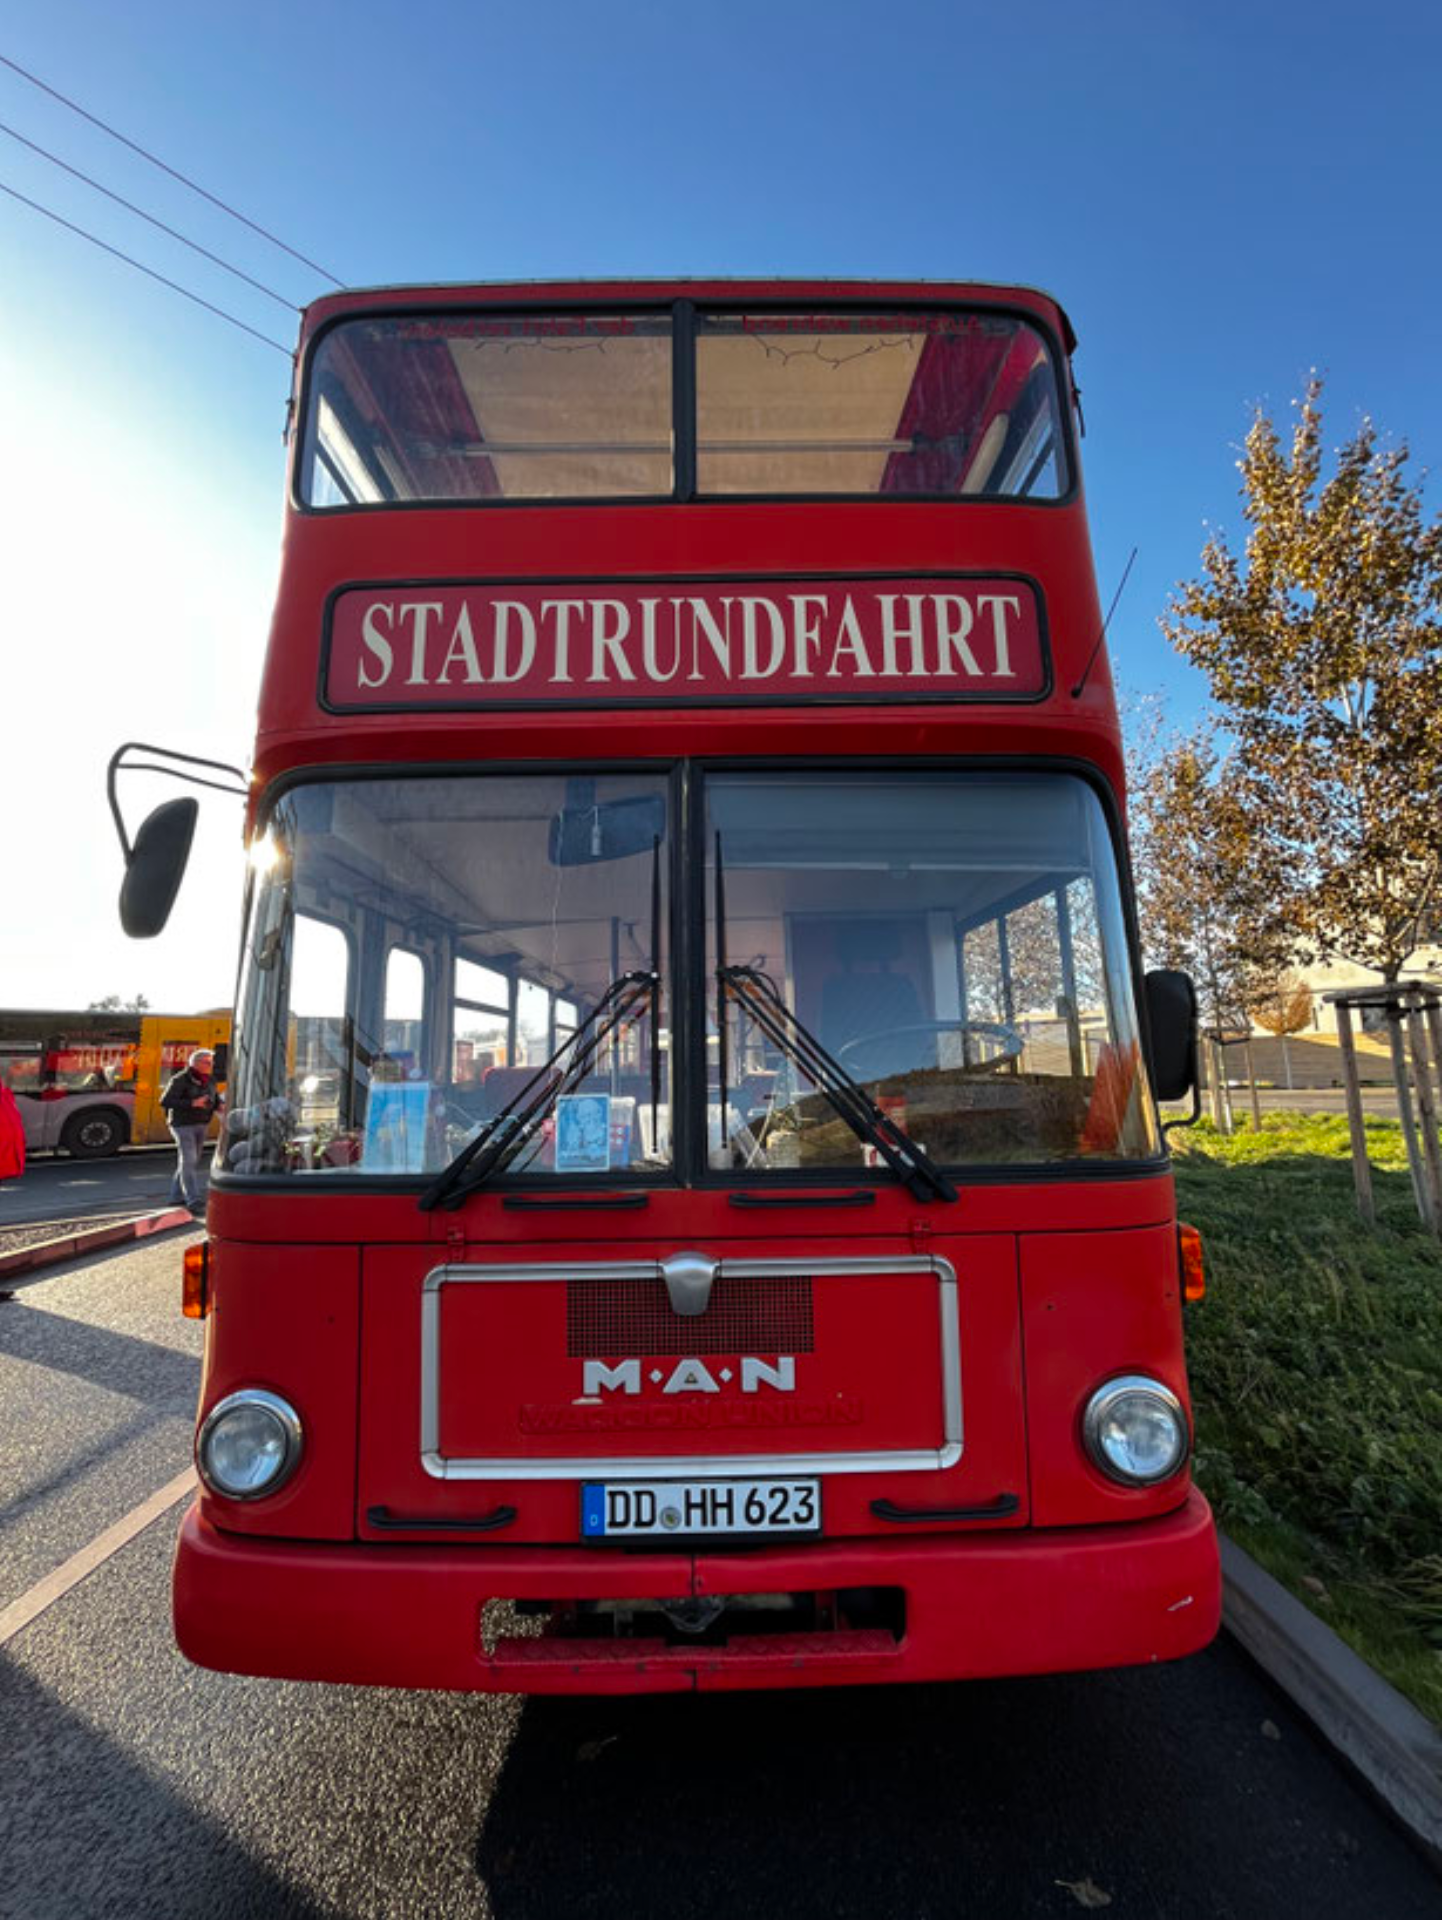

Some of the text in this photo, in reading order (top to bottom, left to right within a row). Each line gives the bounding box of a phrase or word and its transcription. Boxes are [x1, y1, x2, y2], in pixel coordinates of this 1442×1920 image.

[357, 593, 1022, 689] STADTRUNDFAHRT
[607, 1485, 815, 1529] DD HH 623
